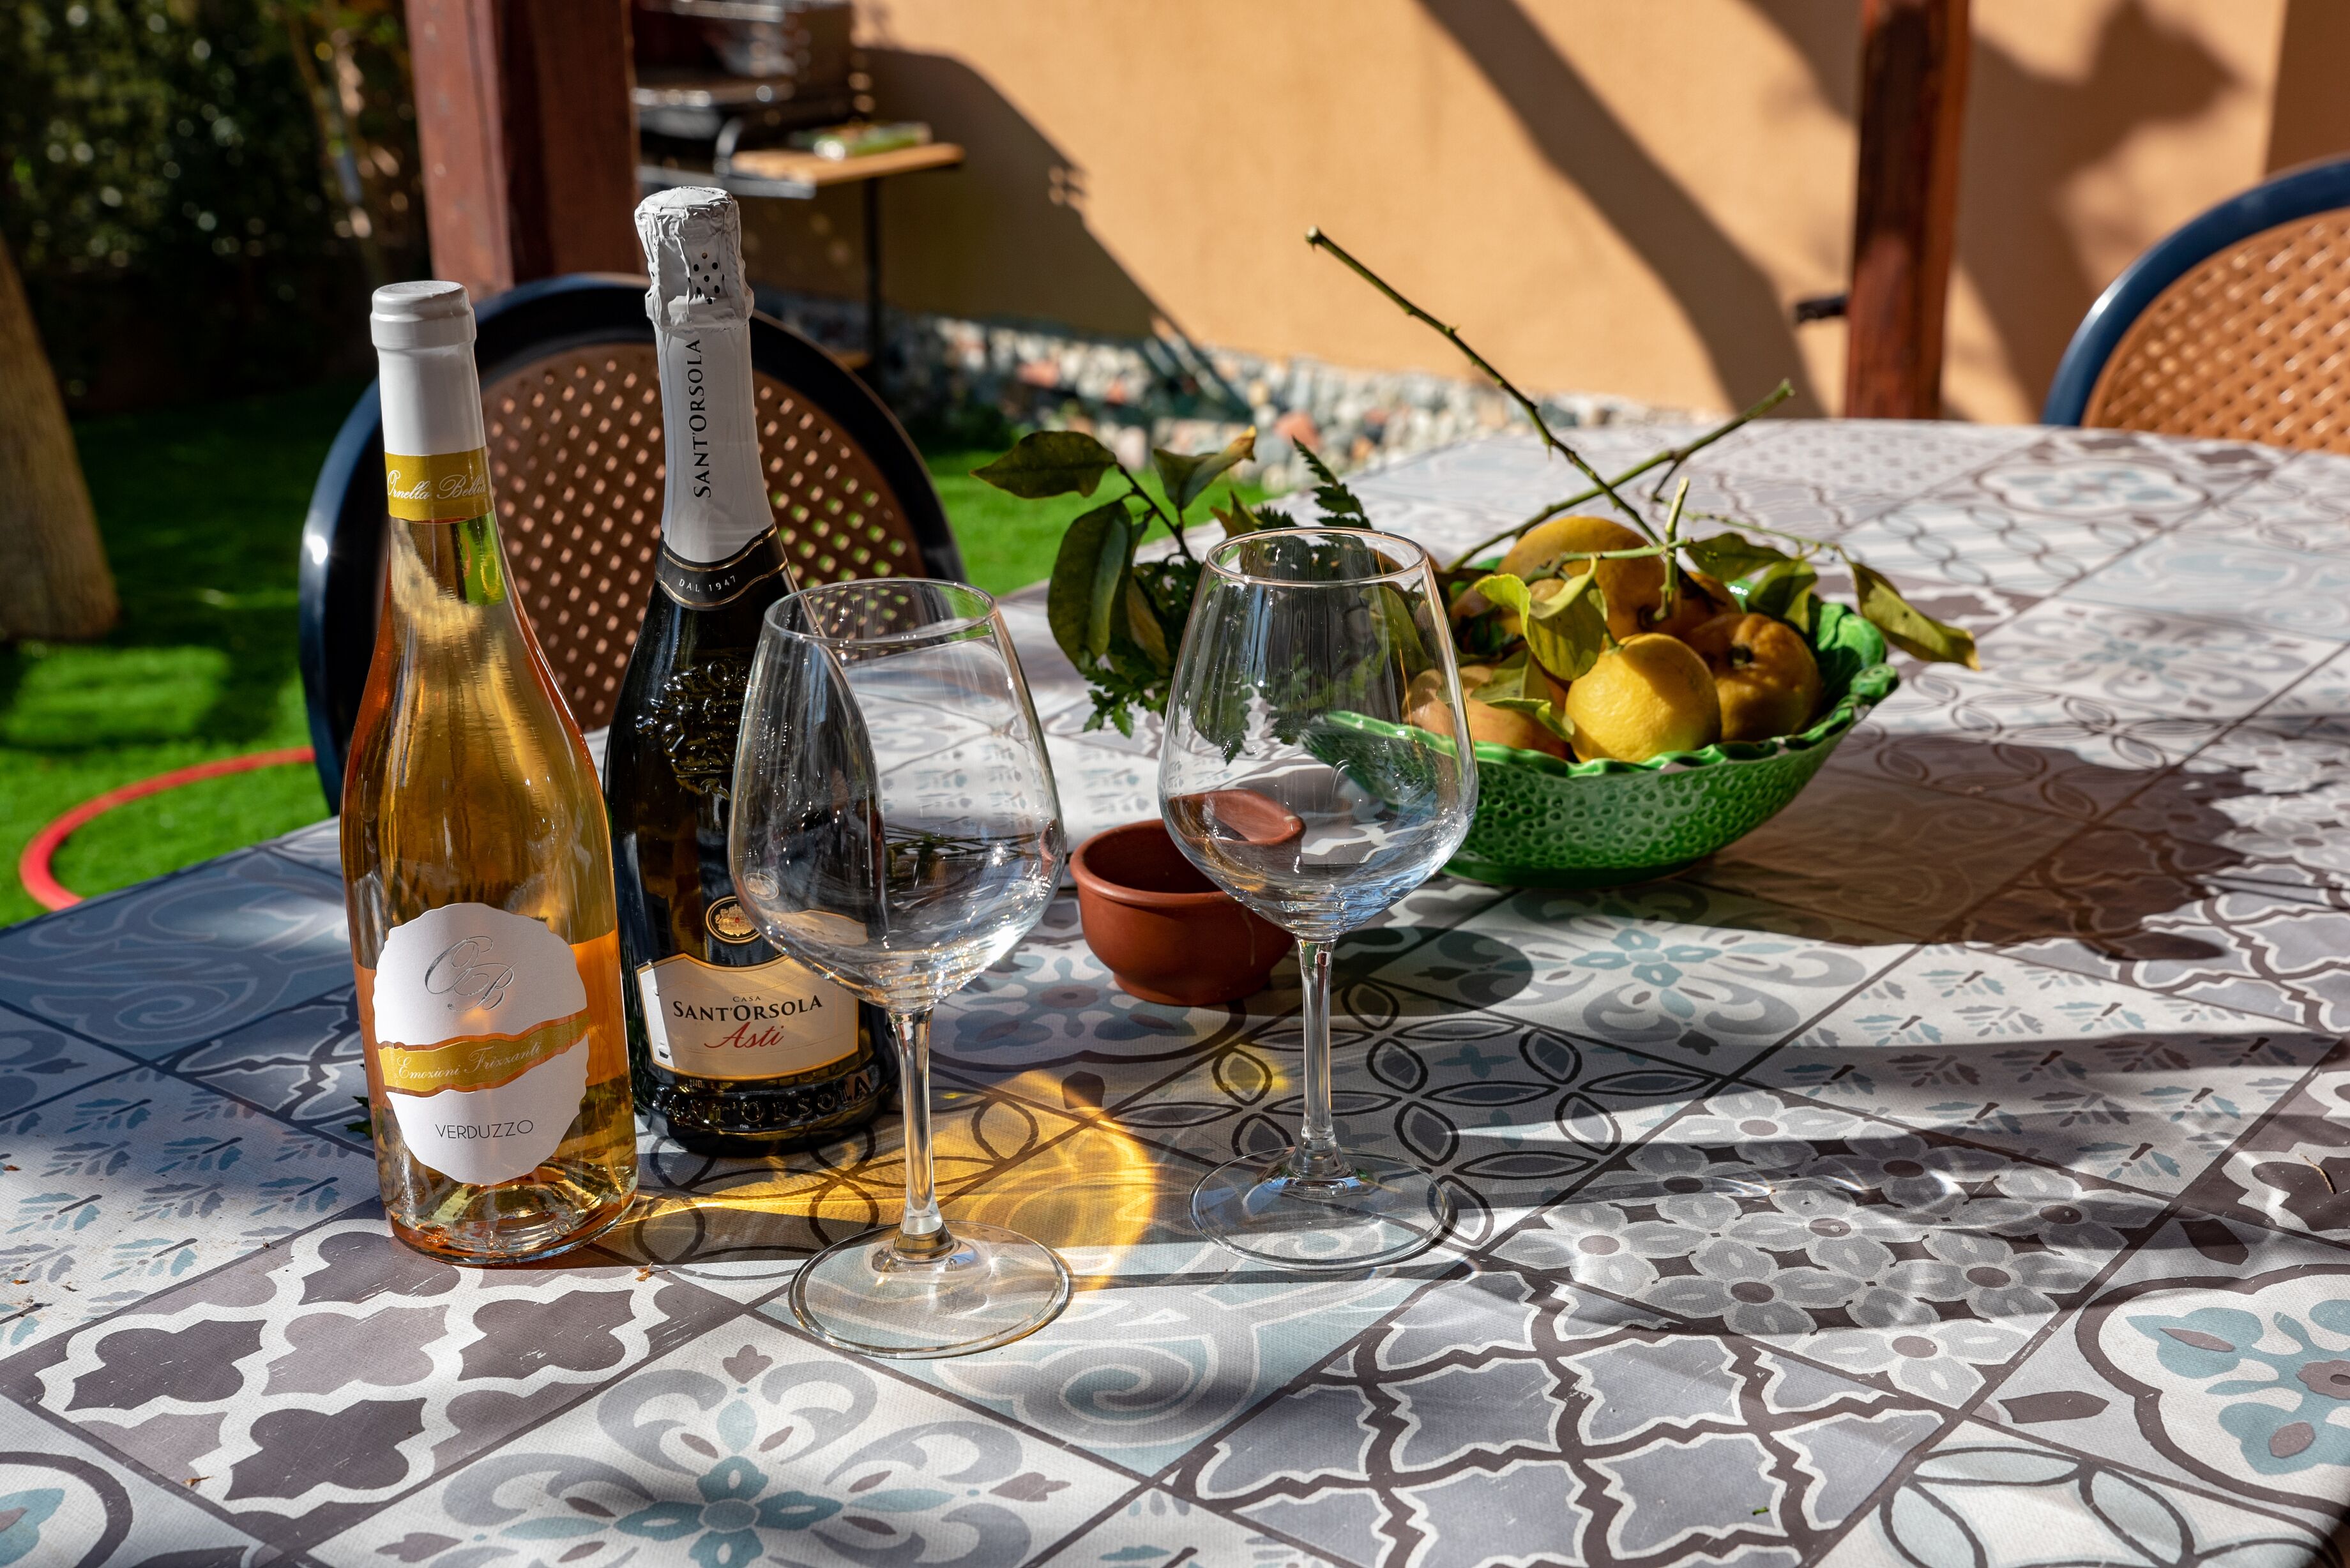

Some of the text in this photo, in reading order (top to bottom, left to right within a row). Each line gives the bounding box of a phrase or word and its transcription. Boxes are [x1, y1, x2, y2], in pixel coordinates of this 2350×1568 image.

[685, 338, 711, 499] SANT'ORSOLA
[387, 470, 487, 500] Ornella Bellia
[679, 575, 736, 592] DAL 1947
[673, 995, 822, 1021] SANT'ORSOLA
[704, 1021, 785, 1048] Asti
[397, 1041, 542, 1079] Emozioni Frizzanti
[435, 1120, 534, 1139] VERDUZZO
